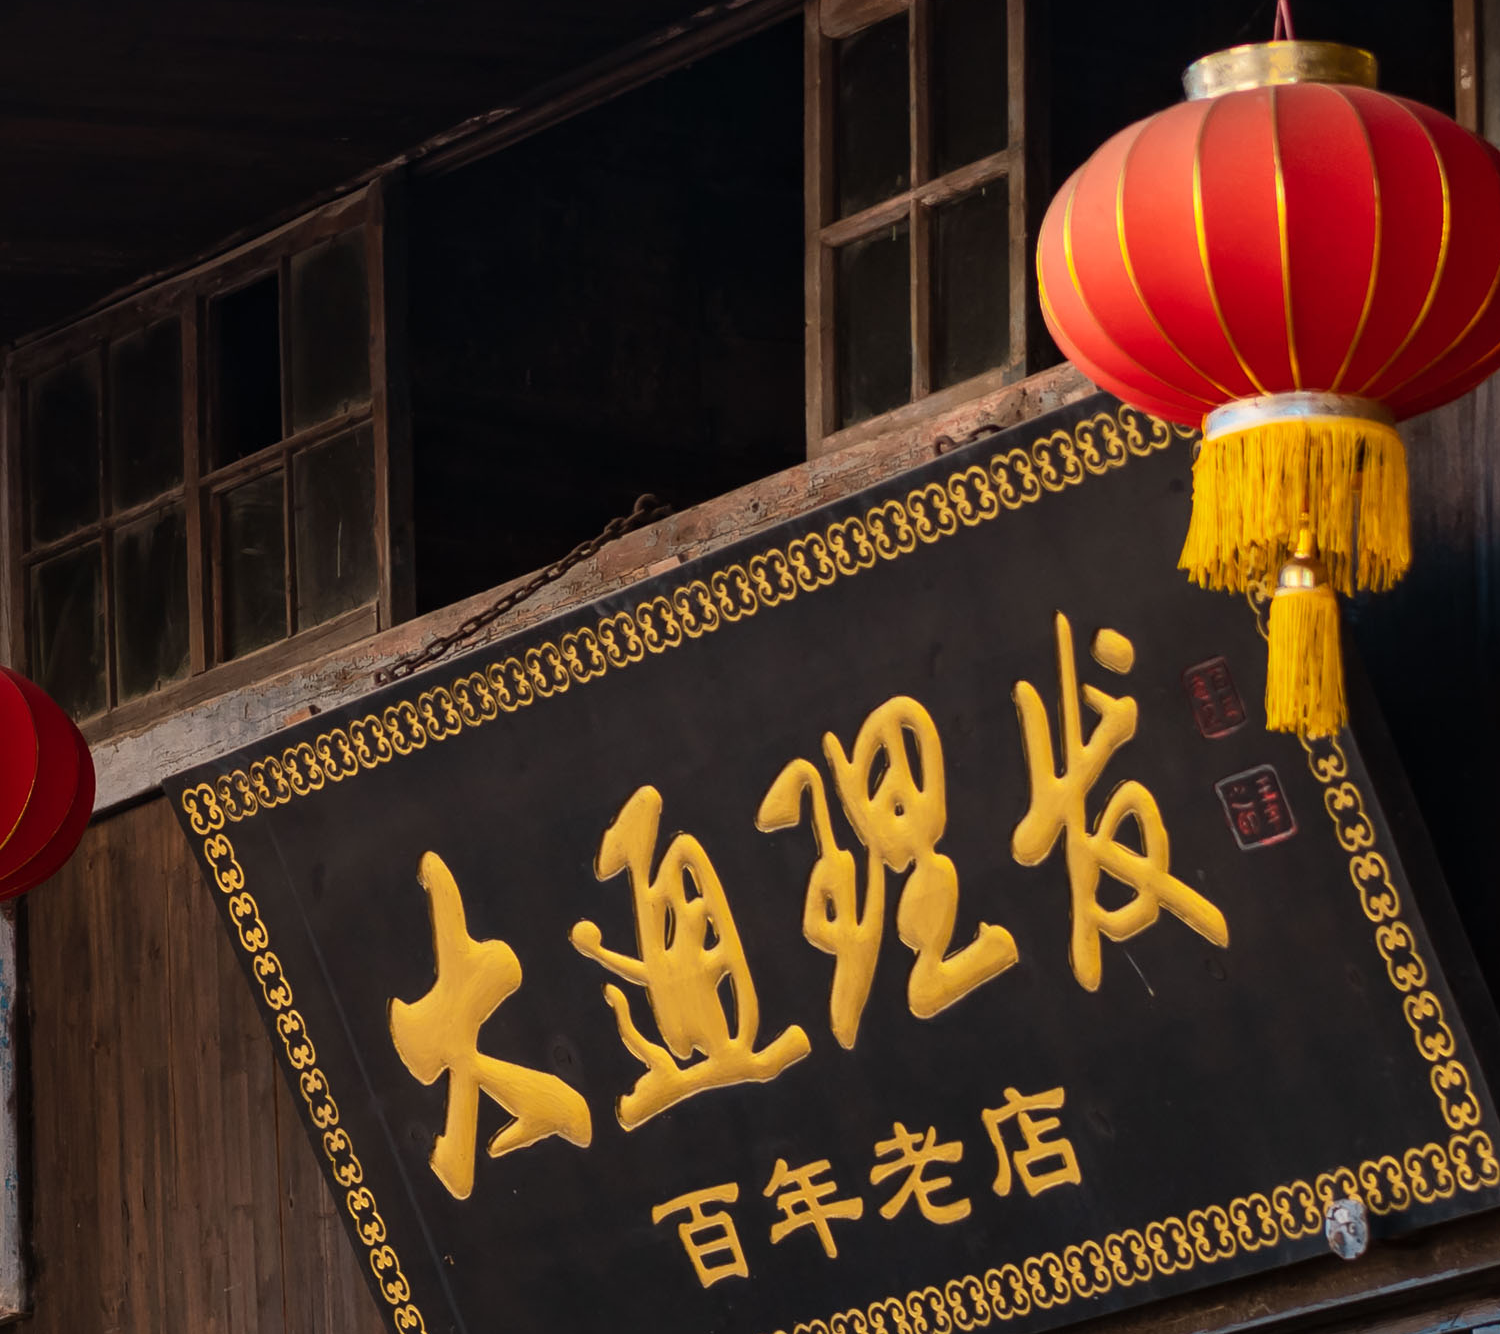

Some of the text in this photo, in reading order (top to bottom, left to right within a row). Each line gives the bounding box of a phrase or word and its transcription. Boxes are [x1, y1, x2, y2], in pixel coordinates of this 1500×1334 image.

[389, 609, 1229, 1200] 大通理发
[652, 1086, 1083, 1289] 百年老店
